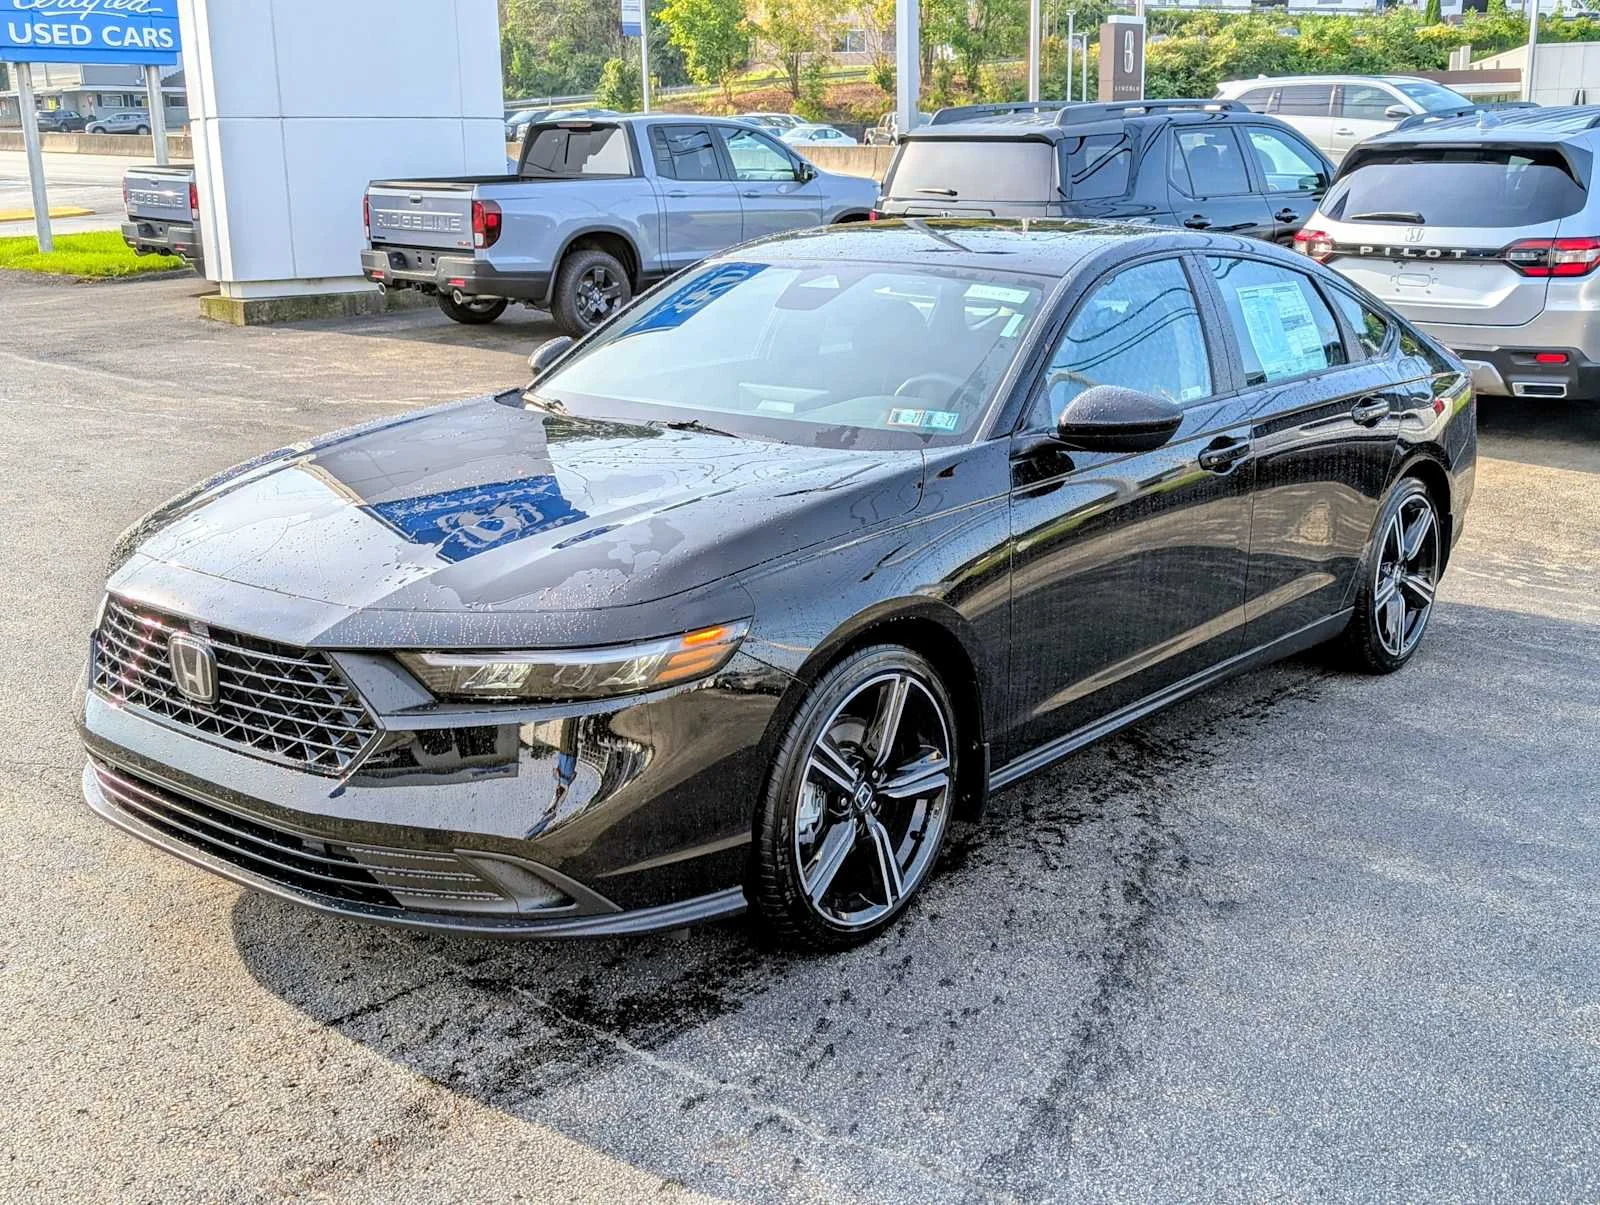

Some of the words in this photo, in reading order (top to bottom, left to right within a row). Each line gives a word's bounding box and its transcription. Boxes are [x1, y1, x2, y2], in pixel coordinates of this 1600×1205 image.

[8, 22, 92, 46] USED
[101, 25, 173, 48] CARS
[376, 213, 463, 232] RIDGELINE
[1359, 246, 1467, 259] PILOT
